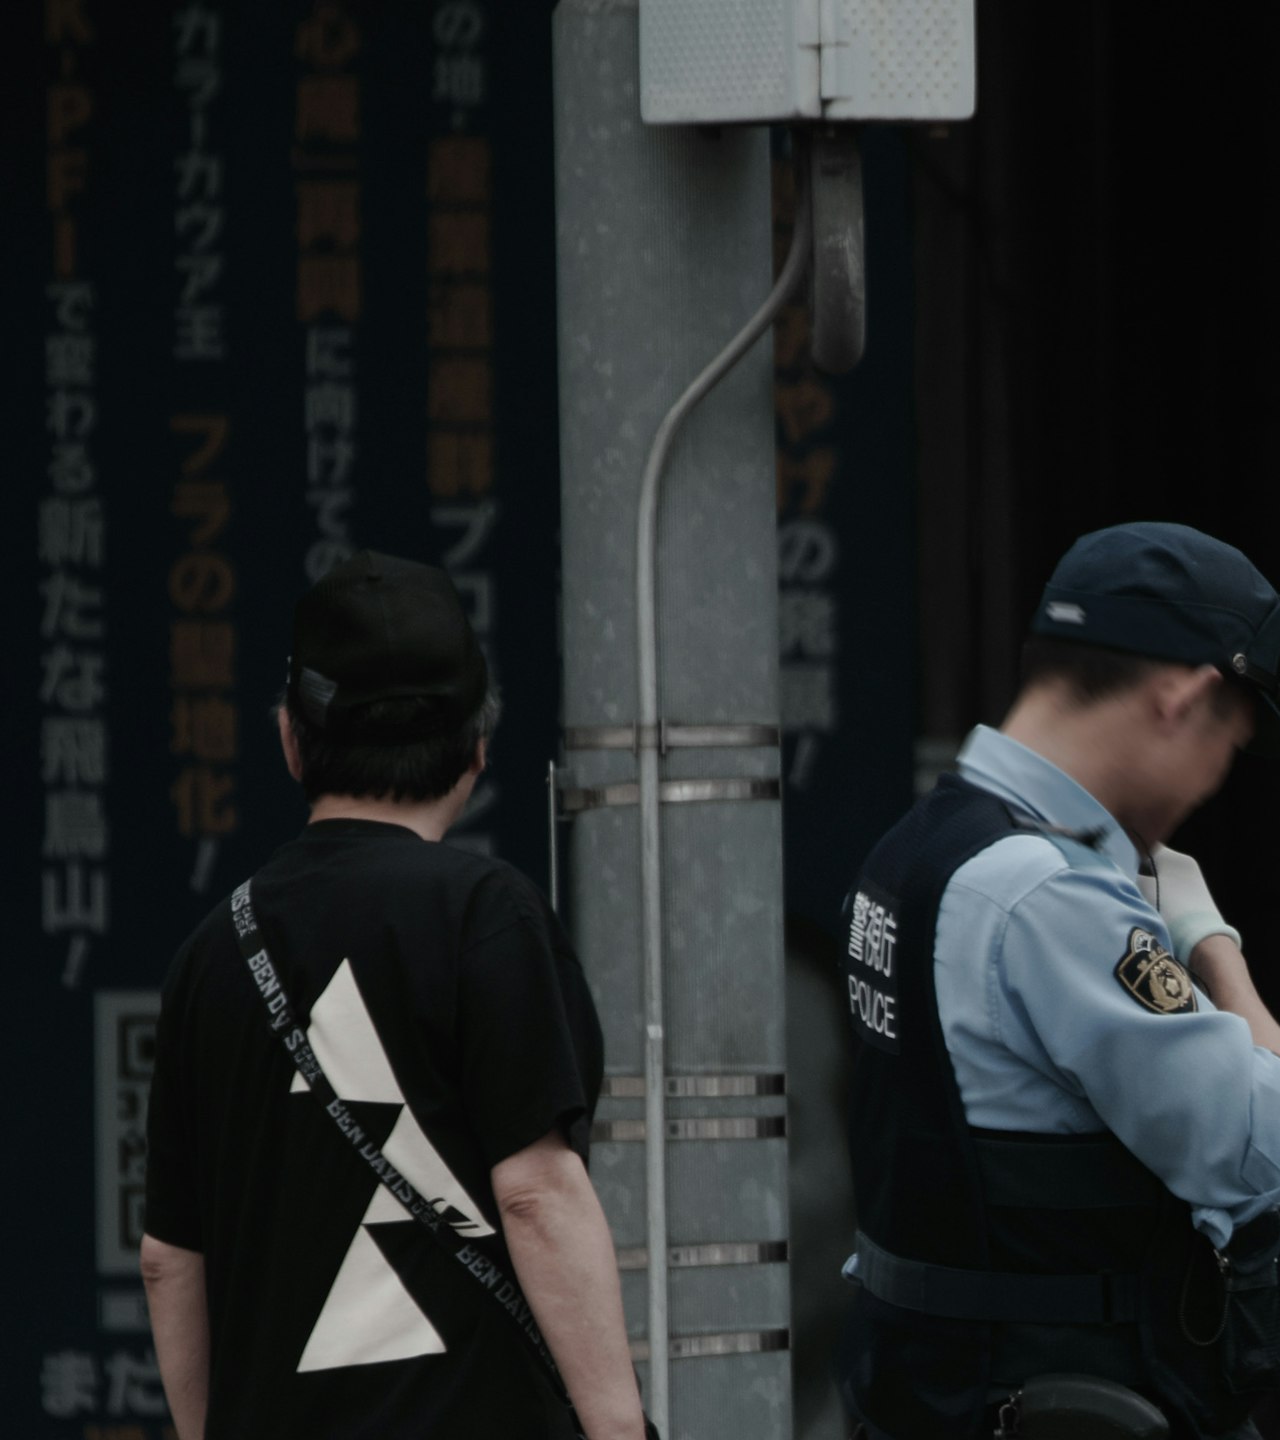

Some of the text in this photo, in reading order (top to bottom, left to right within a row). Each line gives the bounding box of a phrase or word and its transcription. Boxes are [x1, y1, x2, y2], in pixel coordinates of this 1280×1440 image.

[848, 891, 898, 978] 警視庁
[247, 948, 281, 999] BEN
[848, 974, 897, 1040] POLICE
[325, 1099, 366, 1145] BEN
[454, 1243, 503, 1289] BEN
